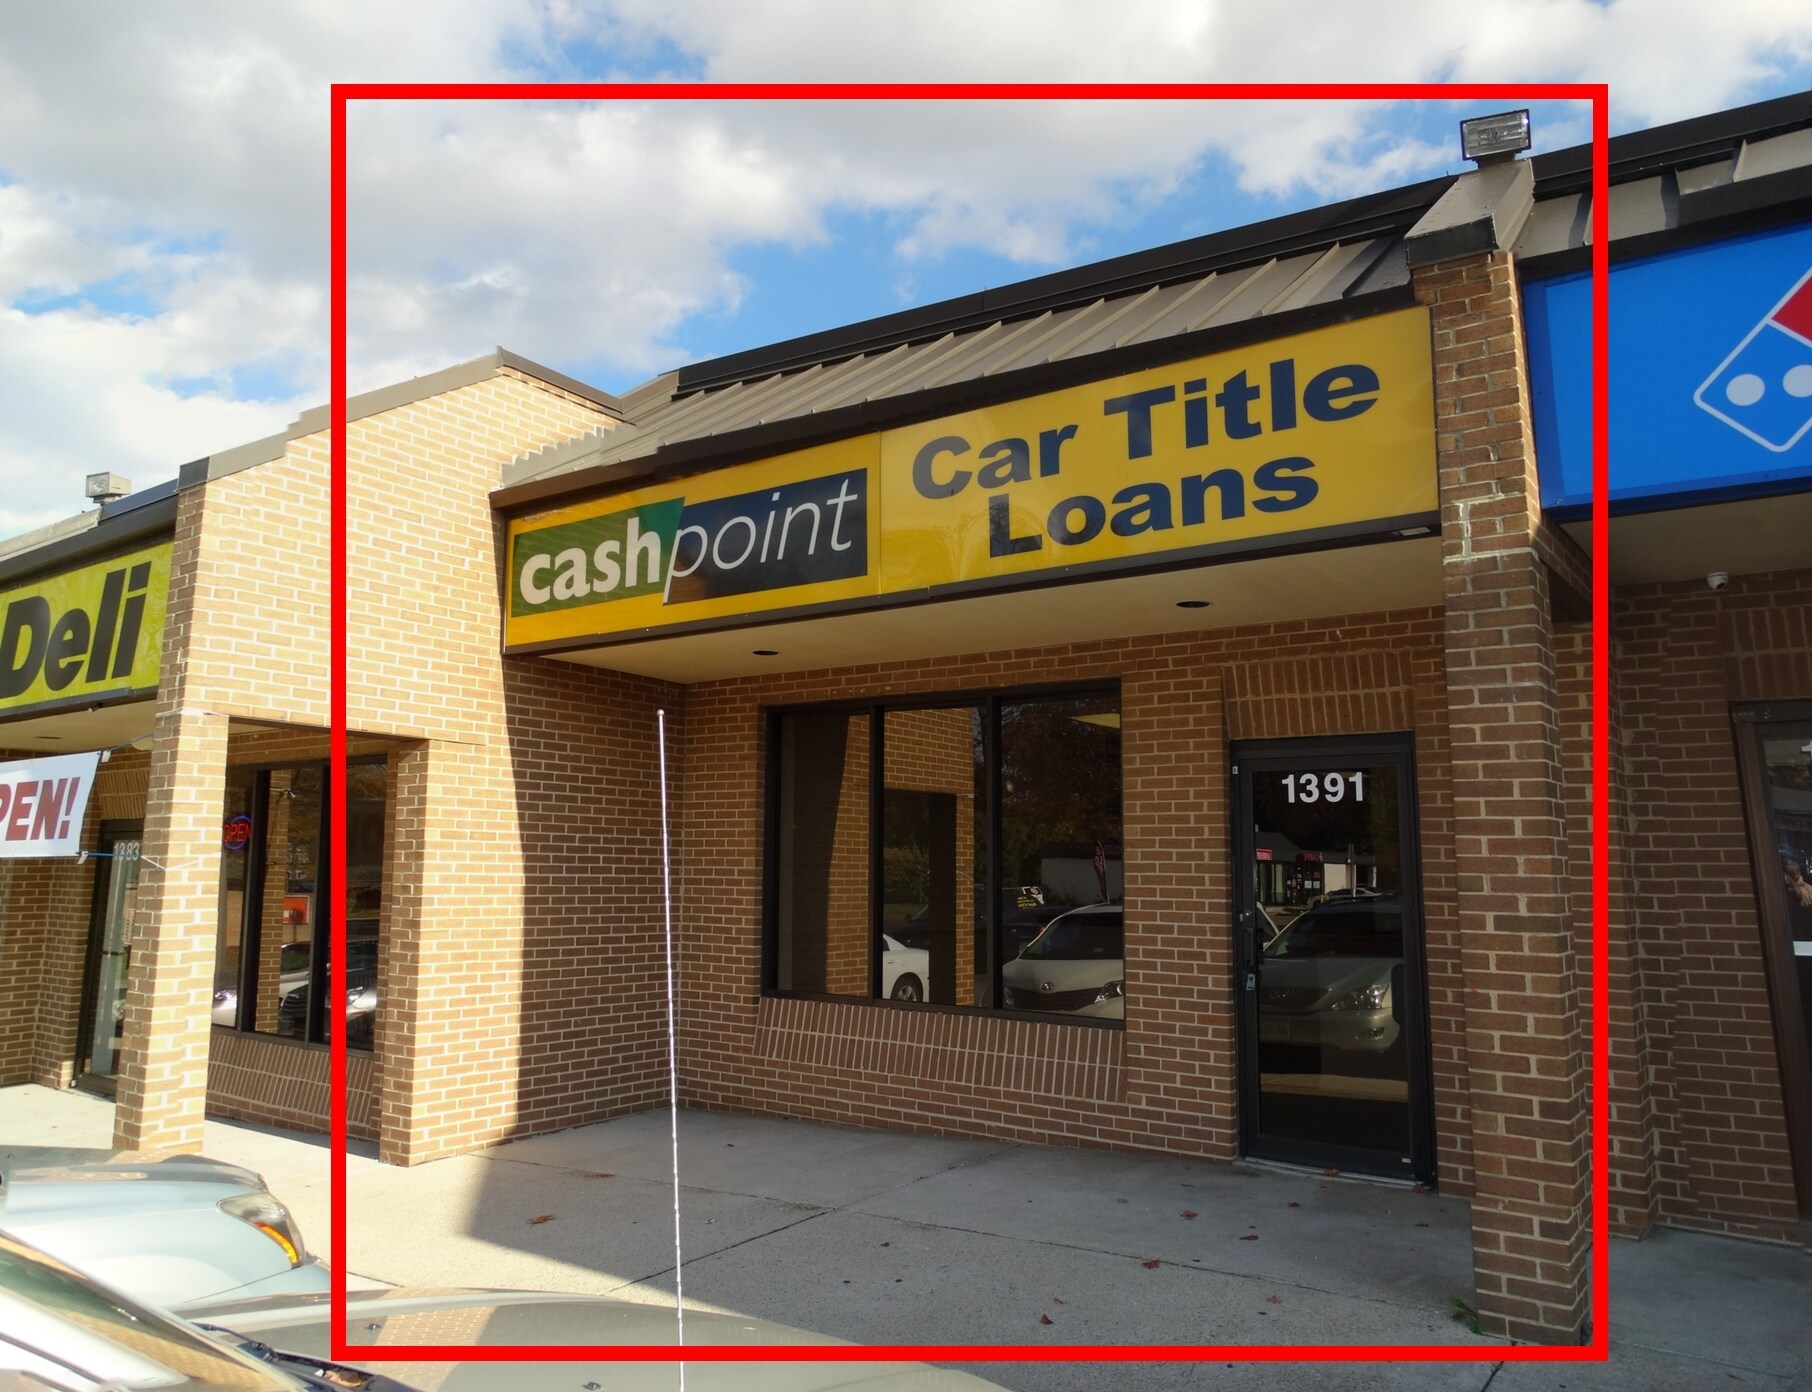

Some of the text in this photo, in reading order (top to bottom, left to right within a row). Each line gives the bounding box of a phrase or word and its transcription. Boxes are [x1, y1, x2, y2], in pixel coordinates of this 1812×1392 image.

[912, 358, 1380, 499] Car Title
[988, 456, 1319, 558] Loans
[0, 561, 152, 697] Deli
[1281, 771, 1364, 803] 1391
[114, 842, 140, 860] 1383
